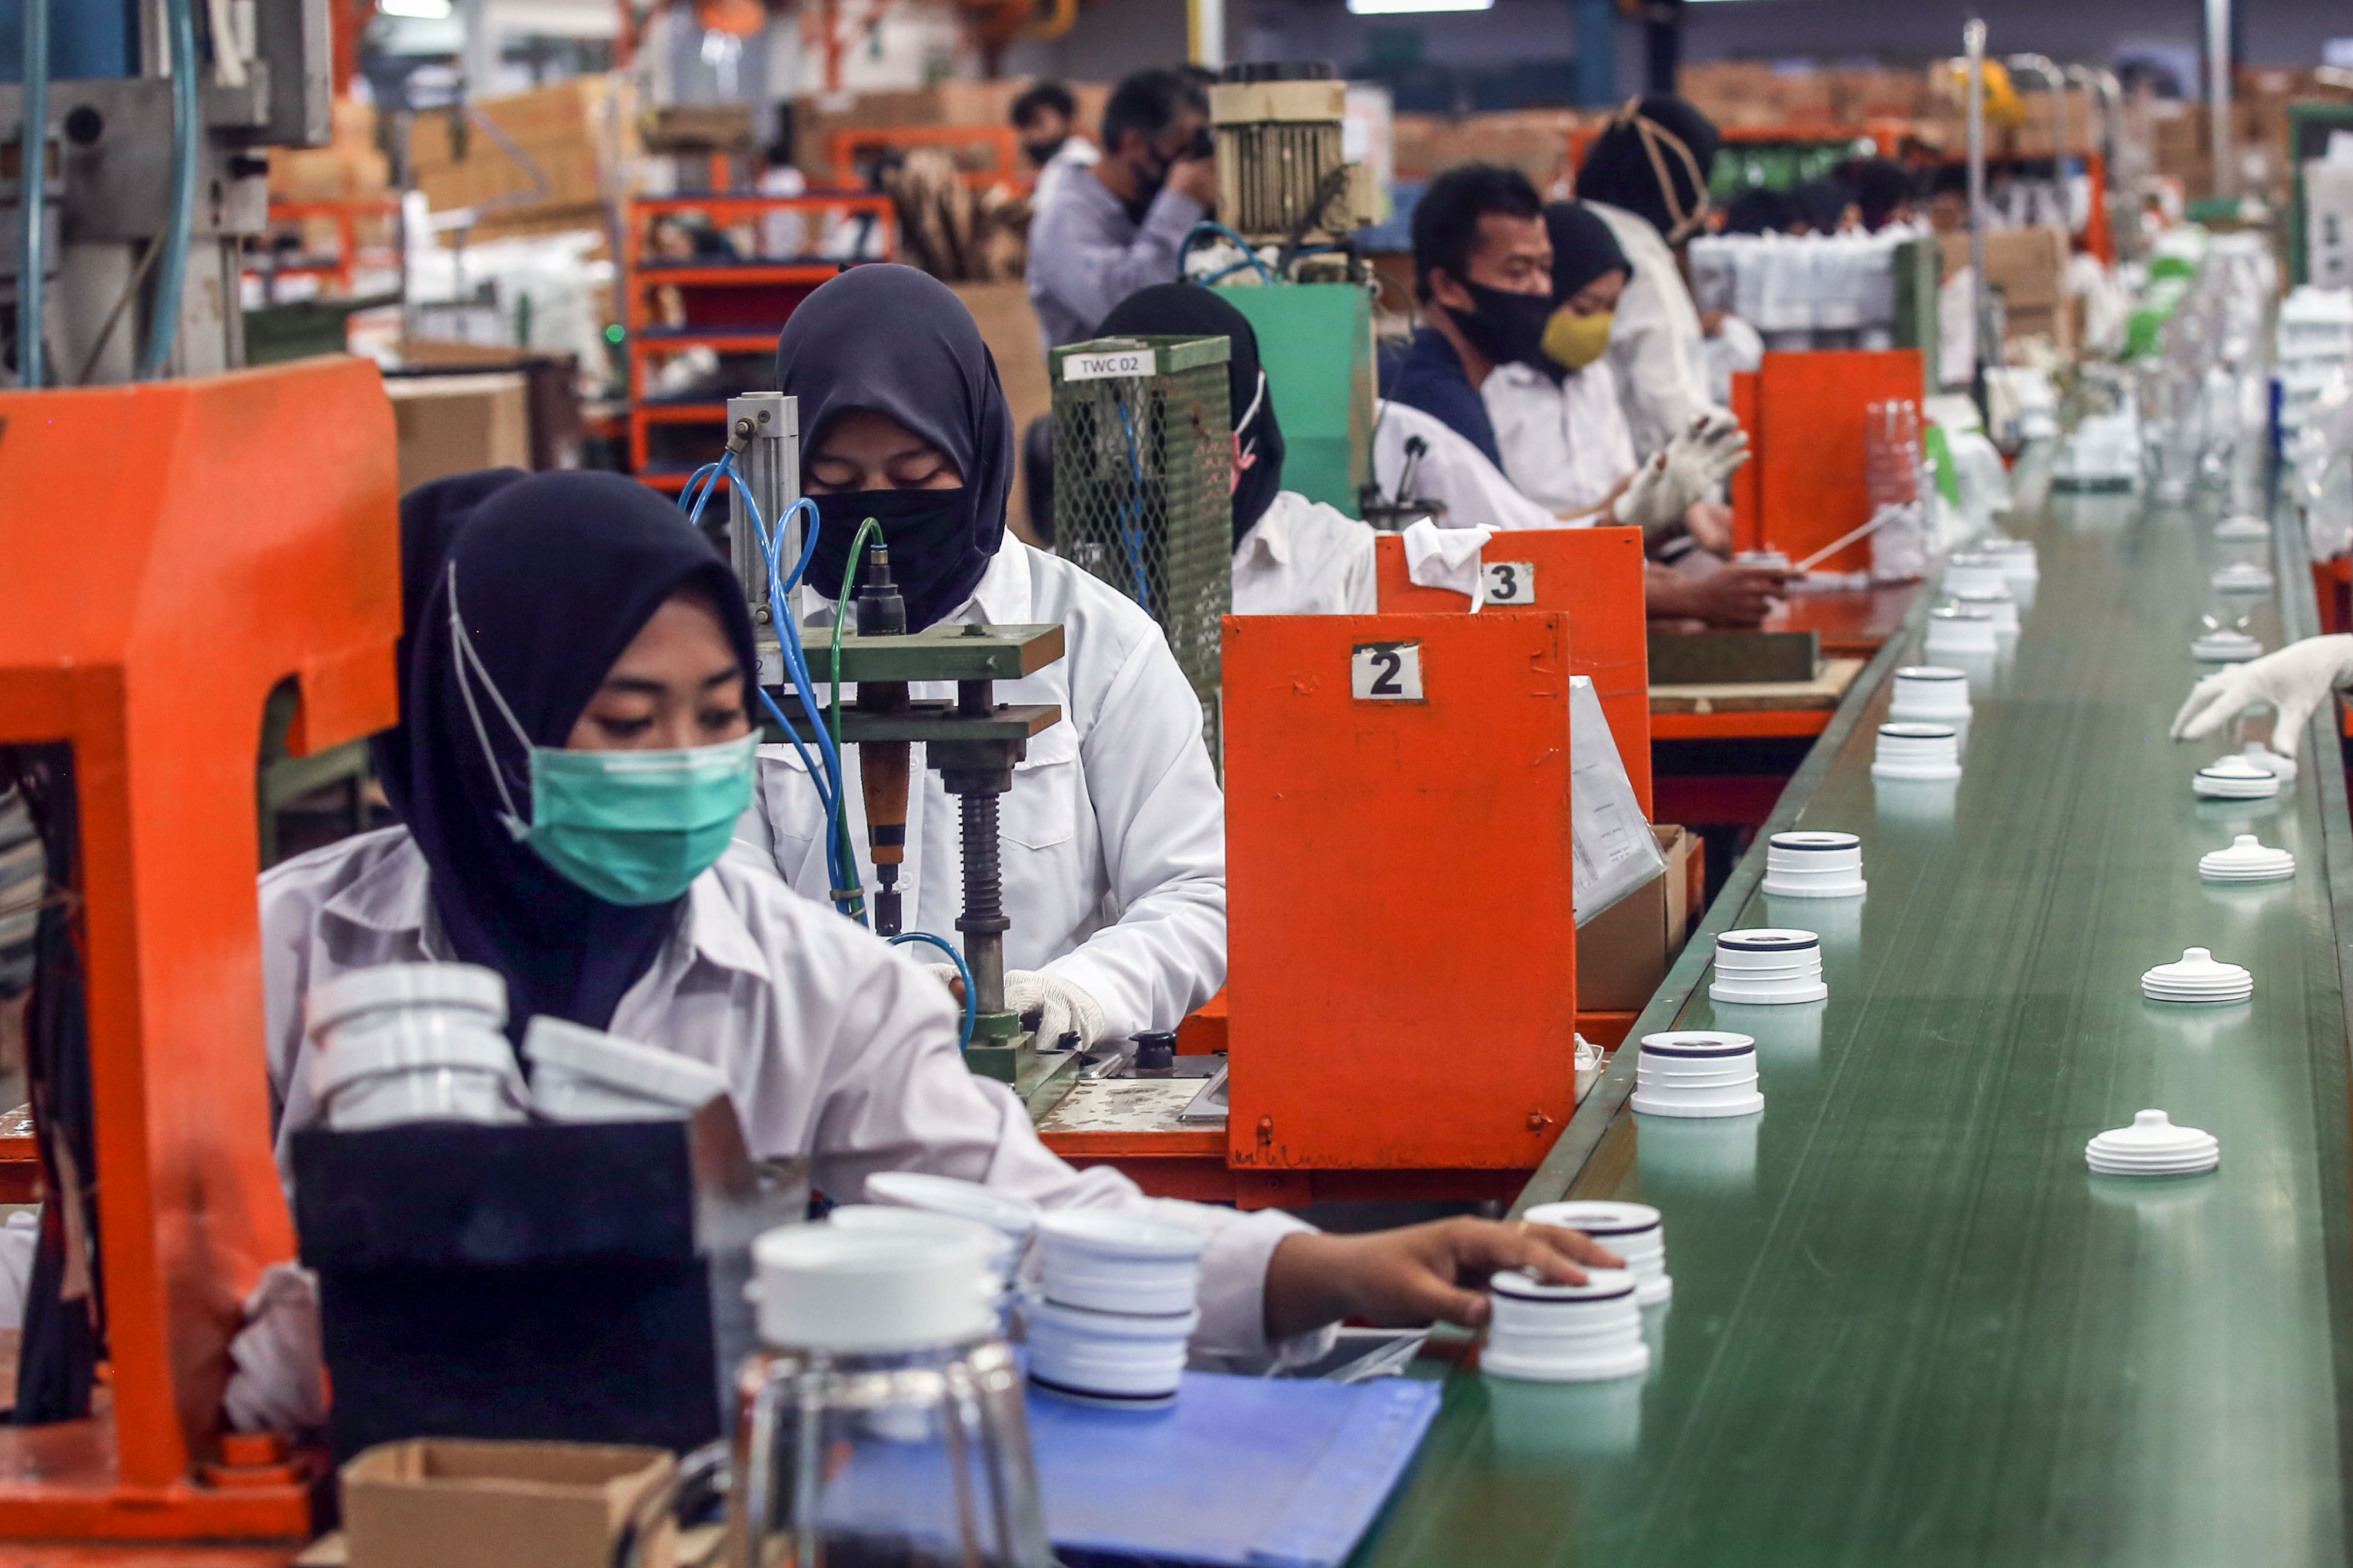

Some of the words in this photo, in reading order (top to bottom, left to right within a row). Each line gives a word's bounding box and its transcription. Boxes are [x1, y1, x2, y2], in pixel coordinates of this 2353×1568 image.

[1081, 358, 1116, 373] TWC
[1120, 356, 1139, 371] 02
[1491, 565, 1517, 599] 3
[1370, 651, 1402, 695] 2
